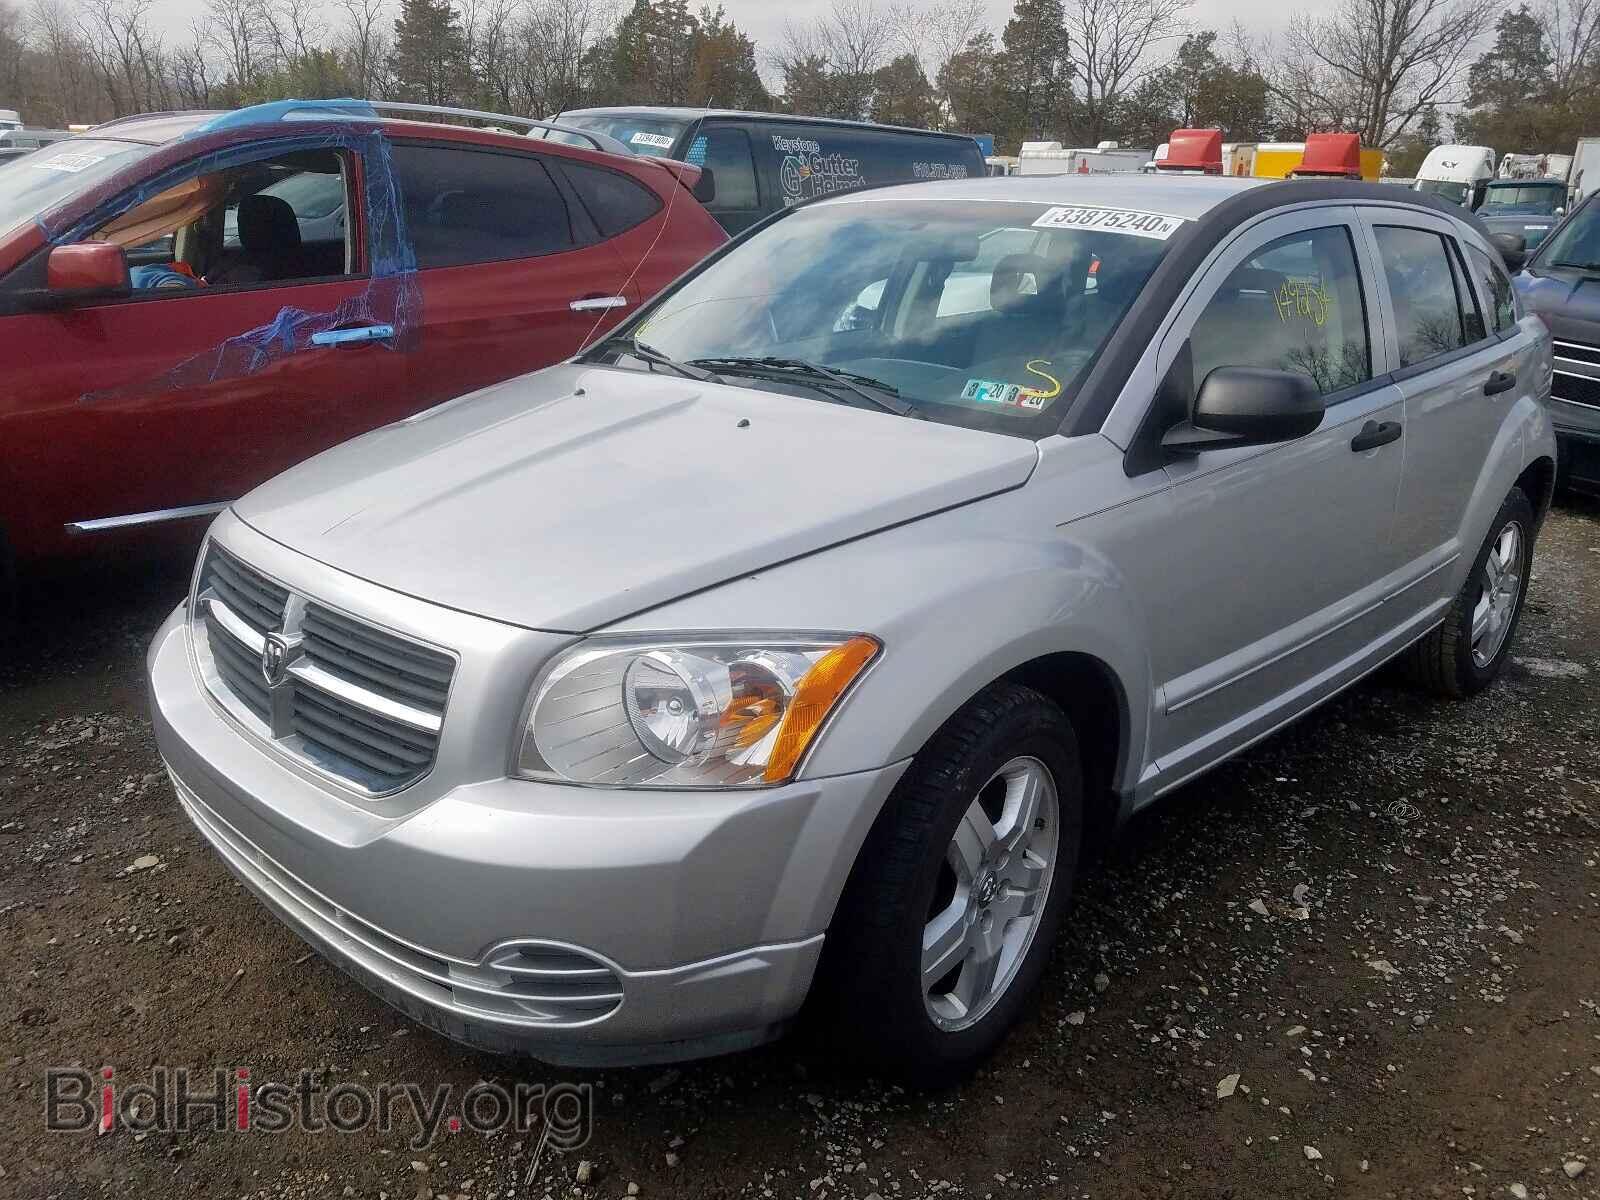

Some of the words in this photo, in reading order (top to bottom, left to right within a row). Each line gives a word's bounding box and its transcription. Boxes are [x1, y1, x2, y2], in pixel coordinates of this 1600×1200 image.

[772, 135, 820, 154] Keystone
[809, 151, 859, 176] Gutter
[1054, 208, 1164, 232] 33875240
[1160, 222, 1173, 233] N
[988, 383, 1006, 399] 20
